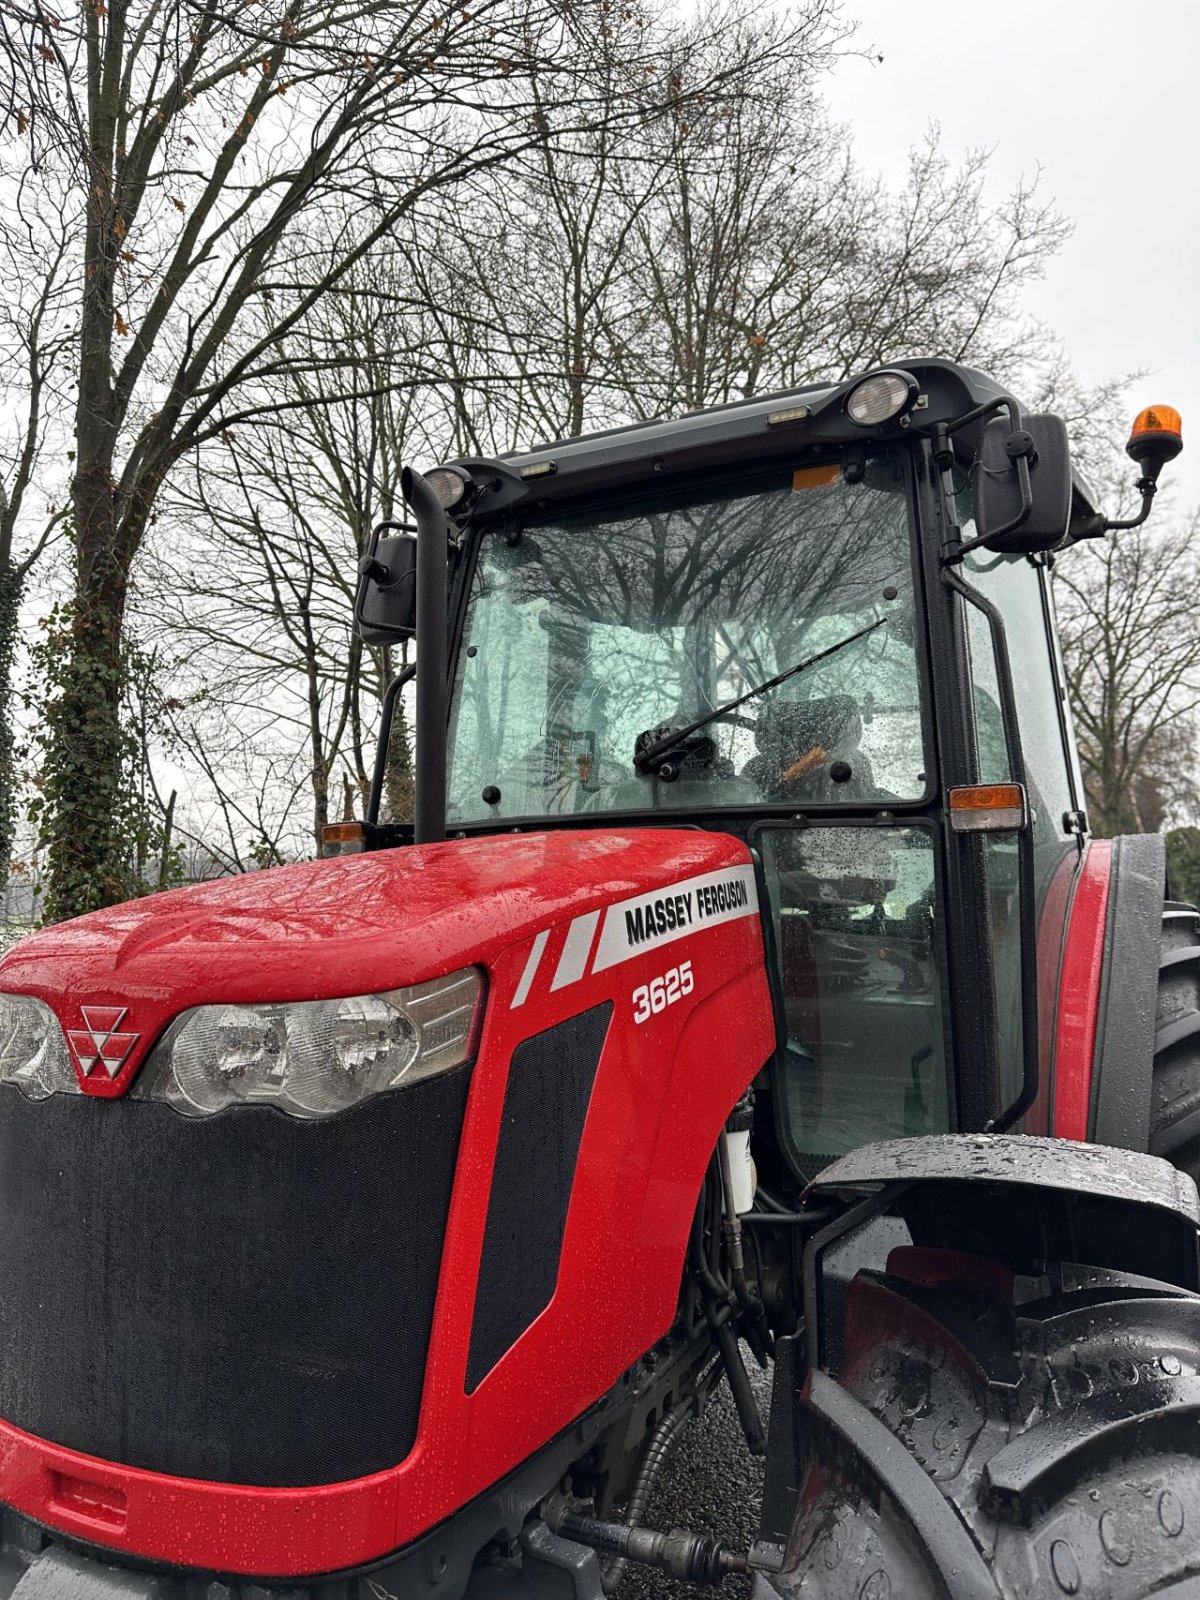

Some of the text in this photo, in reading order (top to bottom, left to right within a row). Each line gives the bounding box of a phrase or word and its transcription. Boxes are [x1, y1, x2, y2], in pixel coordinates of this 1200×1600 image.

[625, 880, 748, 946] MASSEY FERGUSON
[632, 960, 694, 1025] 3625
